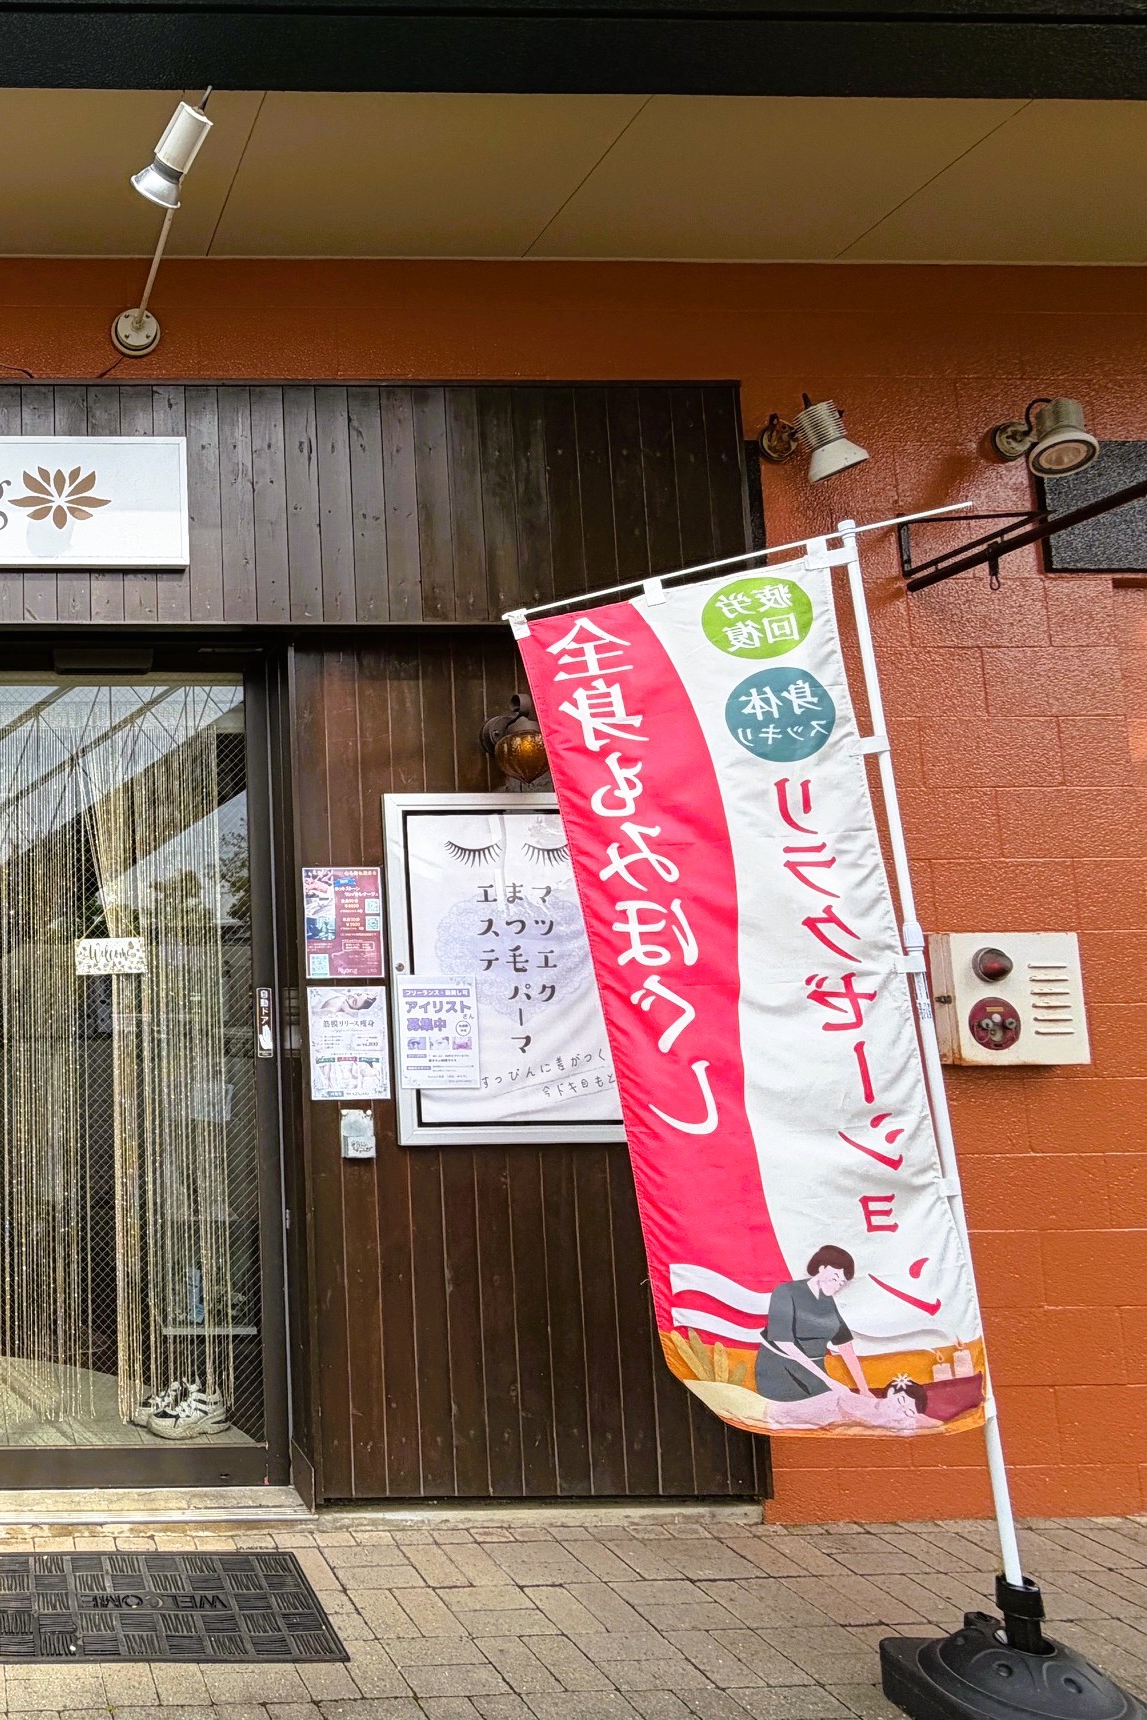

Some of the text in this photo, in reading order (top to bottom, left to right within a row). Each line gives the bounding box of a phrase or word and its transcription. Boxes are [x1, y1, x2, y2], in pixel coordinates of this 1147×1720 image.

[476, 883, 501, 972] エステ
[531, 884, 558, 1002] マツエク
[89, 943, 131, 963] Welcome
[505, 882, 533, 1054] まつ毛パーマ
[405, 1001, 472, 1013] アイリスト
[407, 1017, 447, 1032] 募集中
[481, 1048, 606, 1089] すっぴんに差がつく
